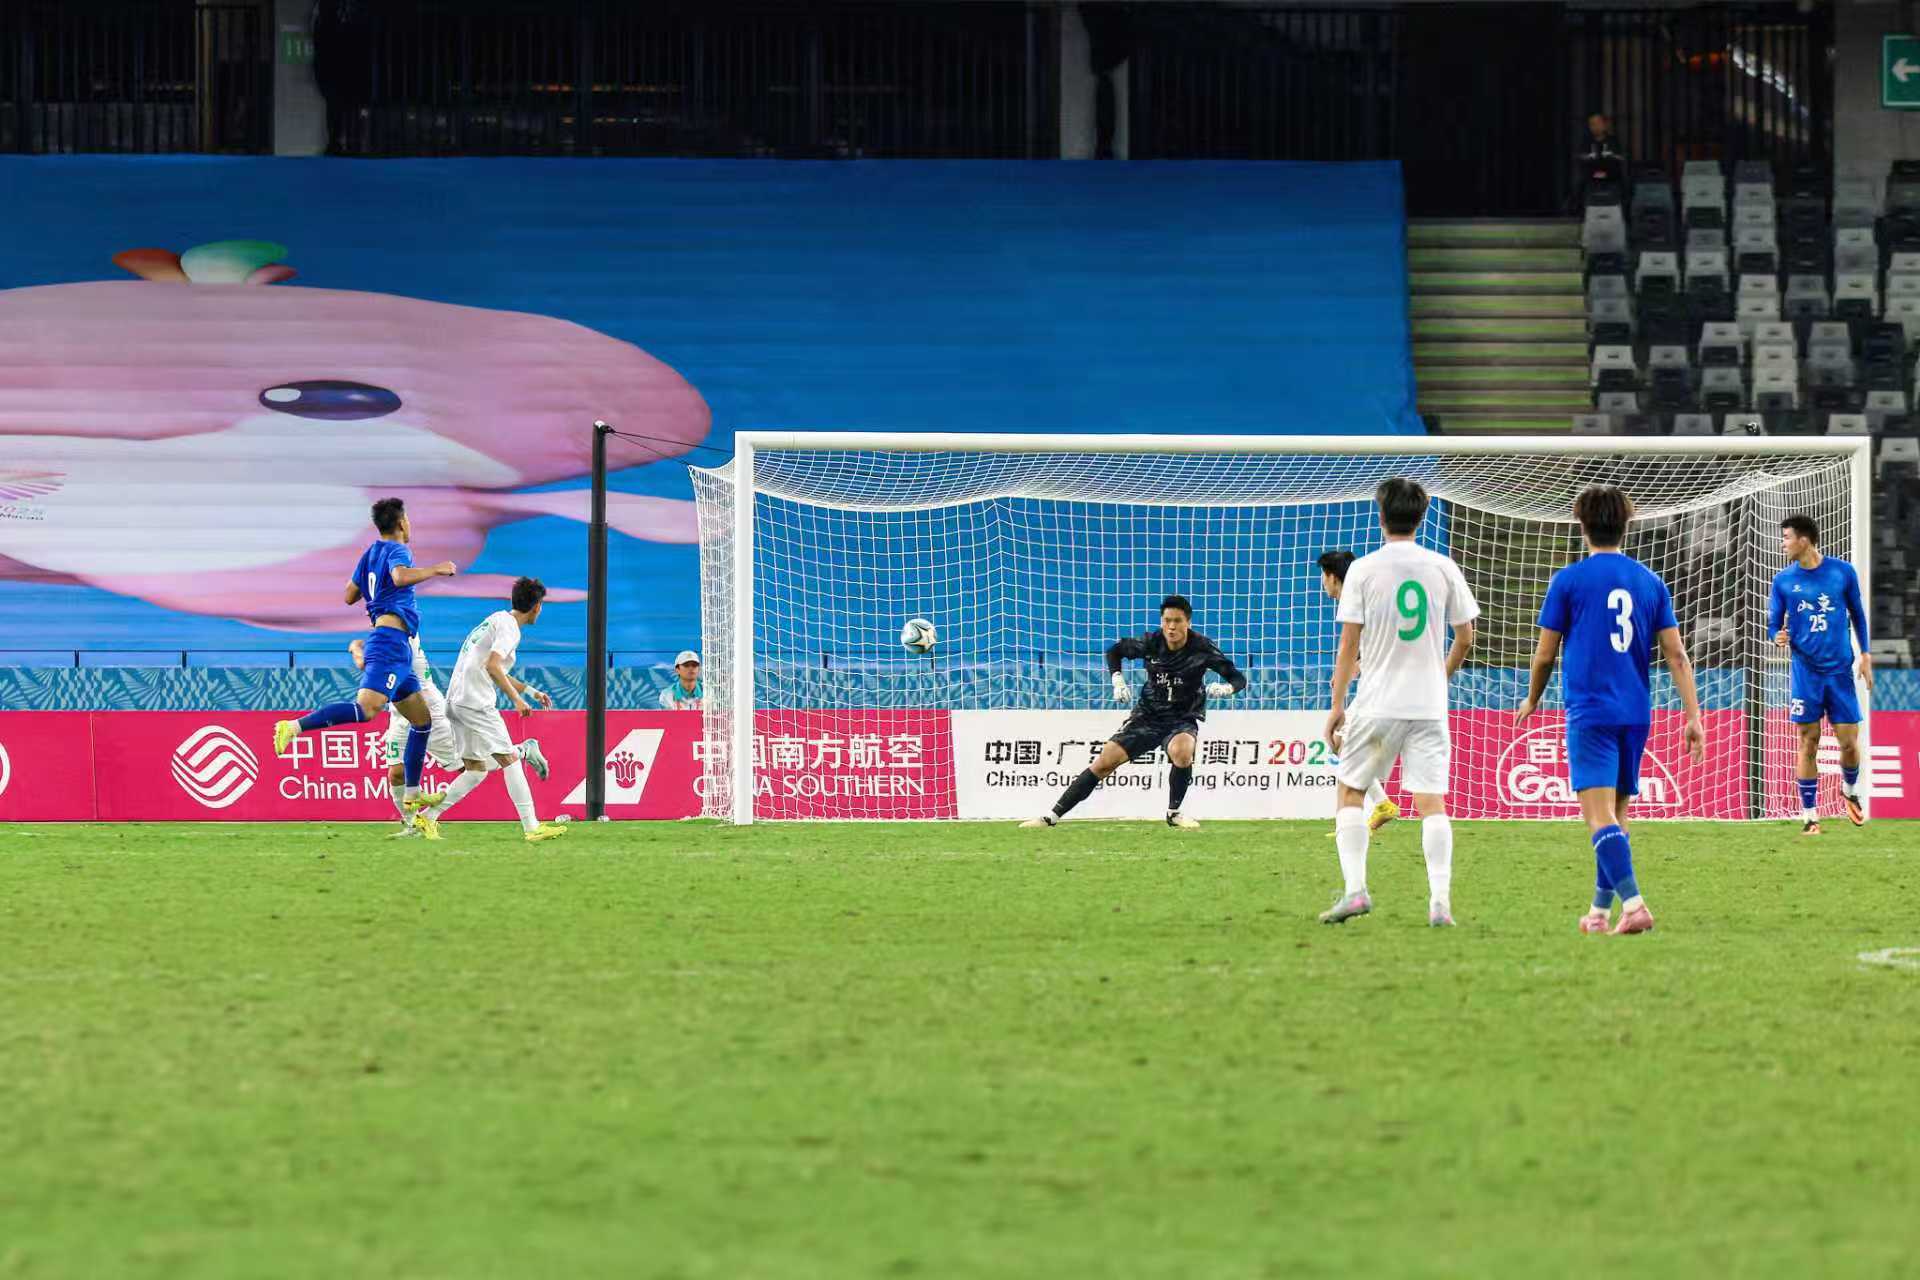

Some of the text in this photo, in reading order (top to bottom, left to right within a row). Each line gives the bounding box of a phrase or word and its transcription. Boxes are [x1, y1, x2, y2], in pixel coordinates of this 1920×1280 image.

[1396, 580, 1428, 641] 9
[1607, 589, 1634, 652] 3
[1808, 614, 1828, 632] 25
[386, 673, 397, 689] 9
[1167, 687, 1172, 701] 1
[1791, 698, 1804, 715] 25
[278, 731, 443, 769] 中国移
[279, 775, 450, 799] China Mile
[783, 775, 924, 797] SOUTHERN
[1186, 773, 1216, 789] ong
[1224, 772, 1270, 790] Kong
[1287, 773, 1338, 787] Maca
